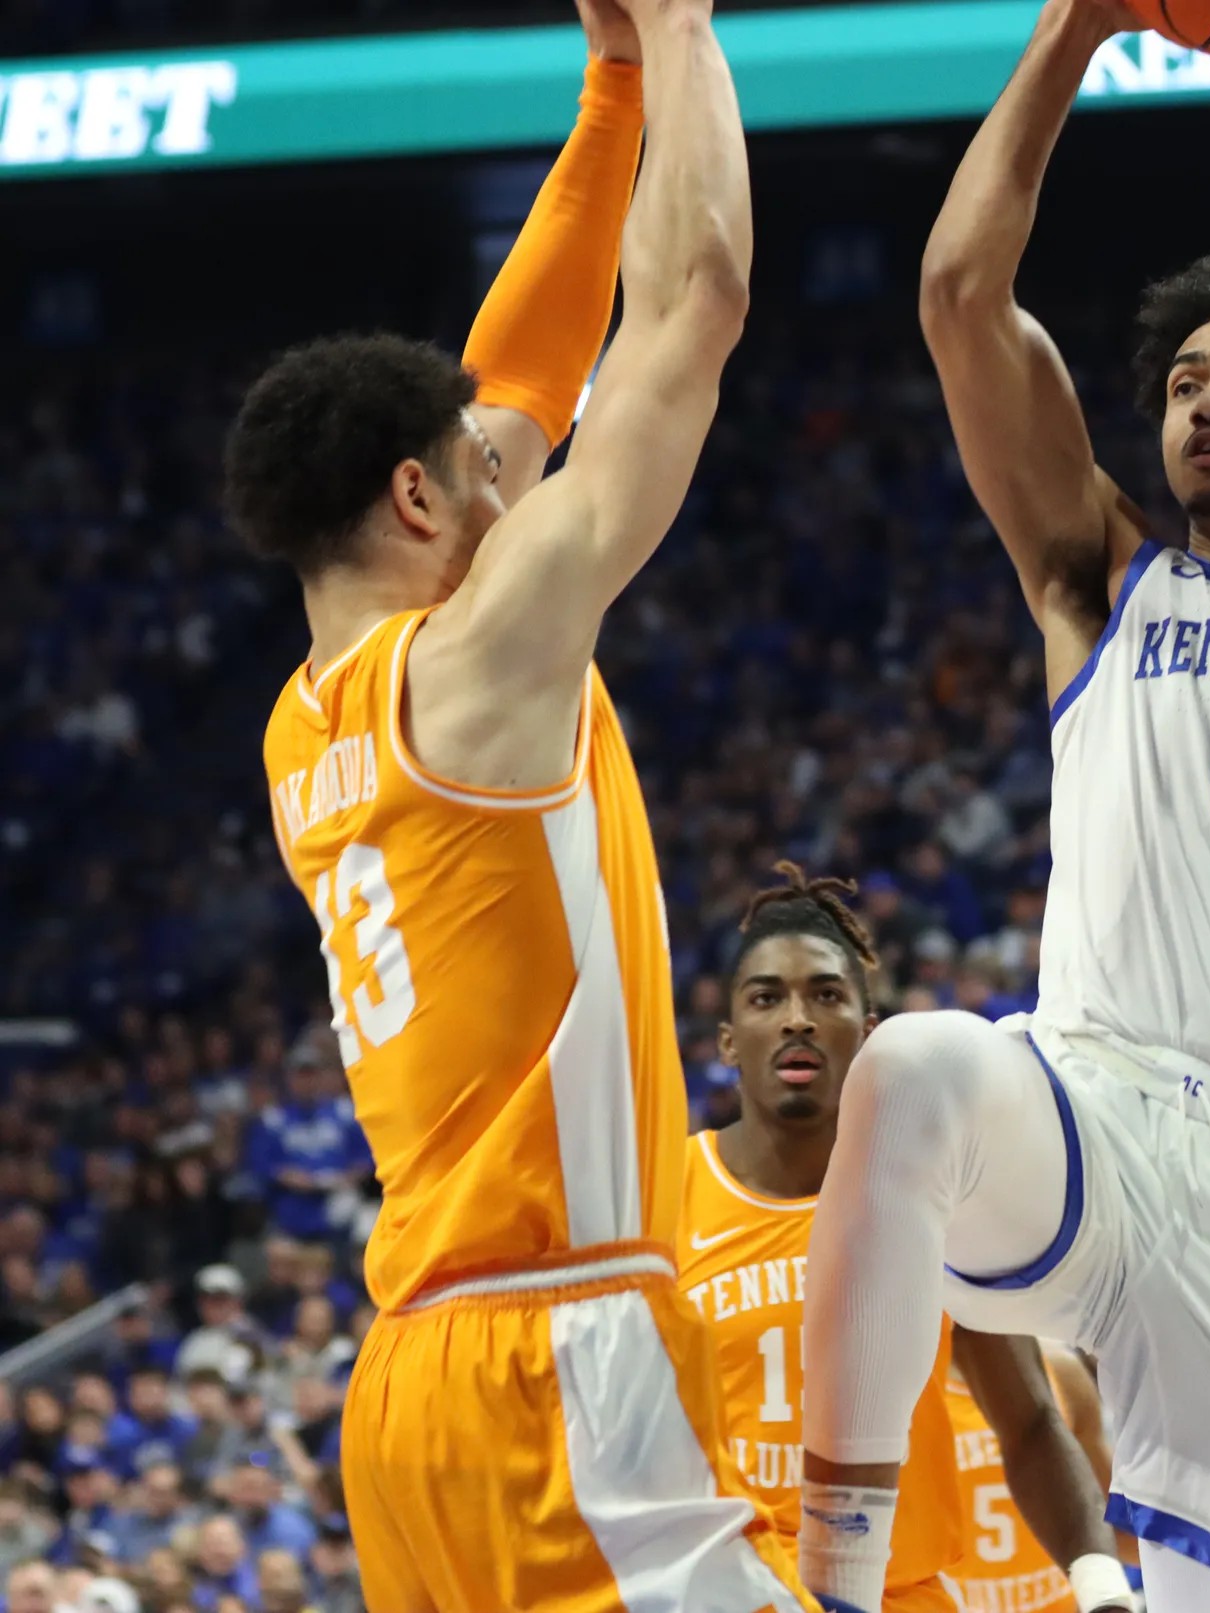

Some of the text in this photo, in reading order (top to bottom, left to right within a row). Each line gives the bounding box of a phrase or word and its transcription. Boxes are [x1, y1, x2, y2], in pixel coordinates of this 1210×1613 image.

[315, 842, 416, 1068] 13
[758, 1326, 805, 1422] 1
[729, 1437, 804, 1489] LUN
[974, 1483, 1016, 1563] 5
